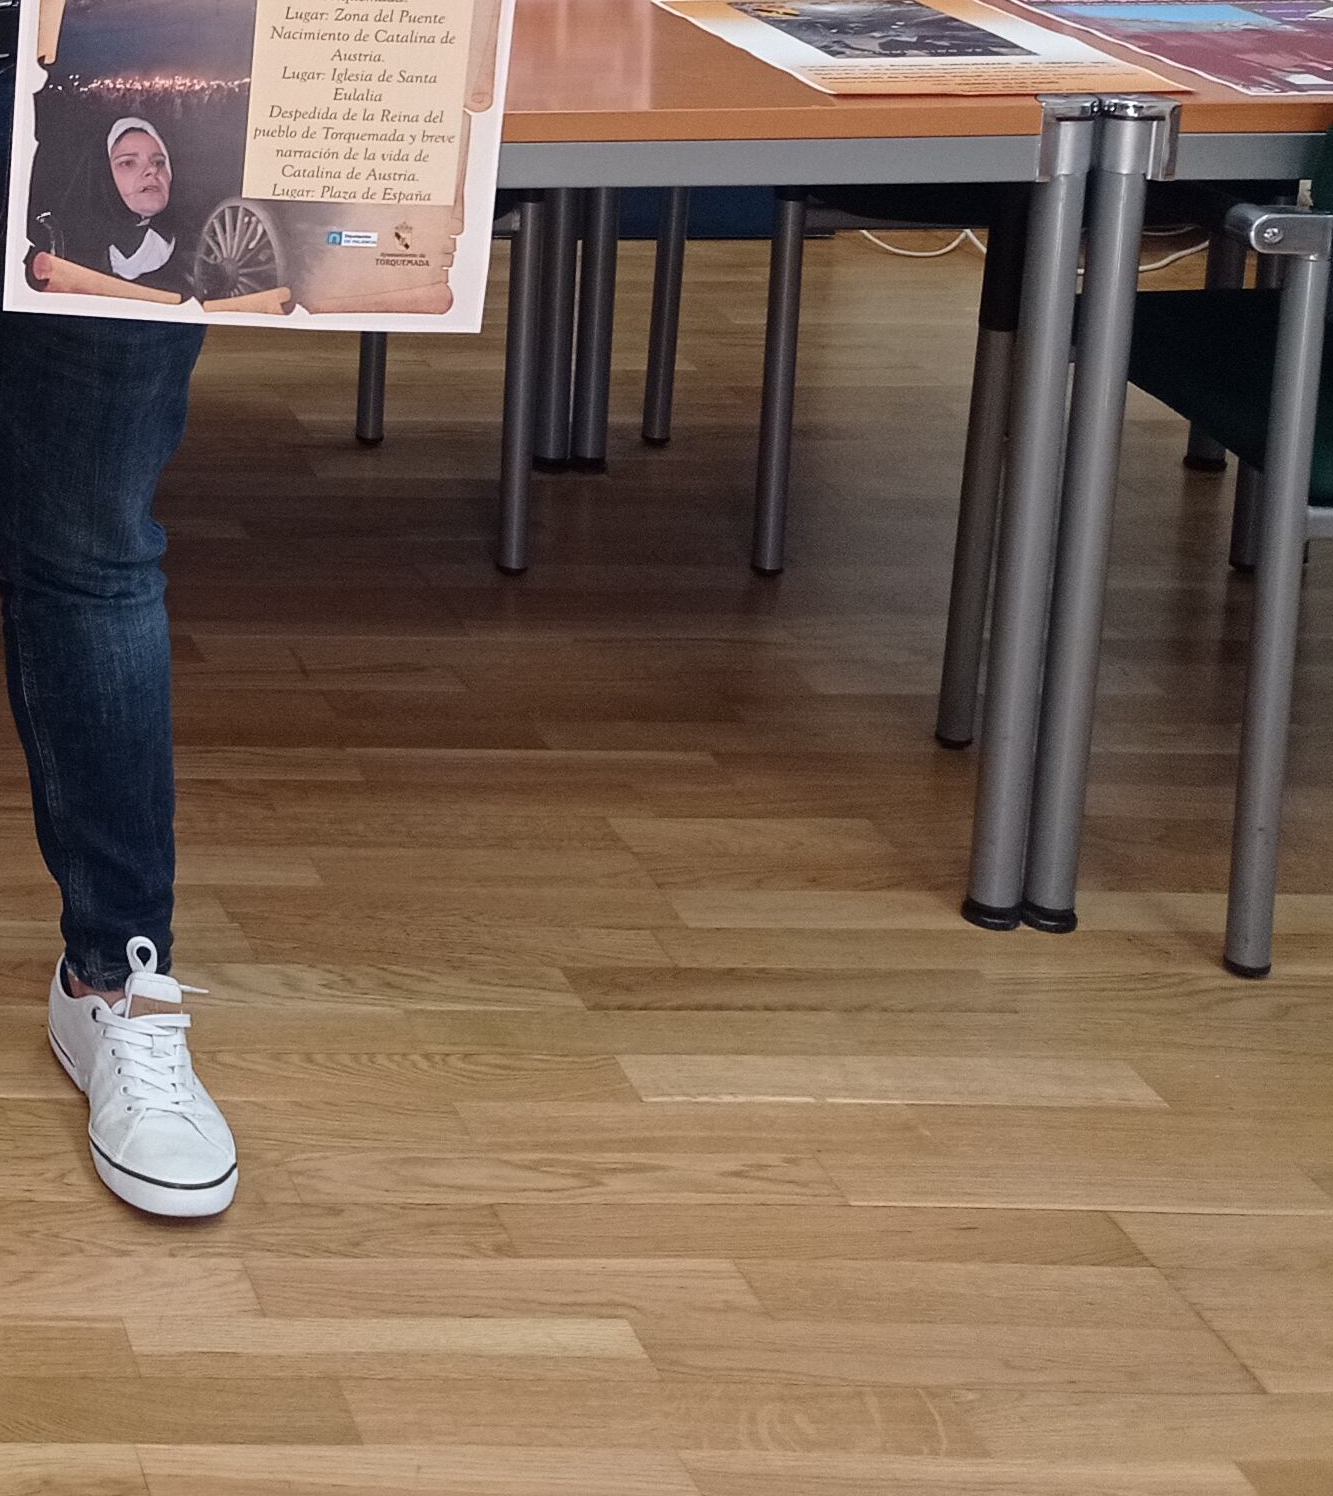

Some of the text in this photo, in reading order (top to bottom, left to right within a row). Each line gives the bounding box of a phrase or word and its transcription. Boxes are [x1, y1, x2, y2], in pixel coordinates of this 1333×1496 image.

[271, 183, 431, 204] Lugar: Plaza de España
